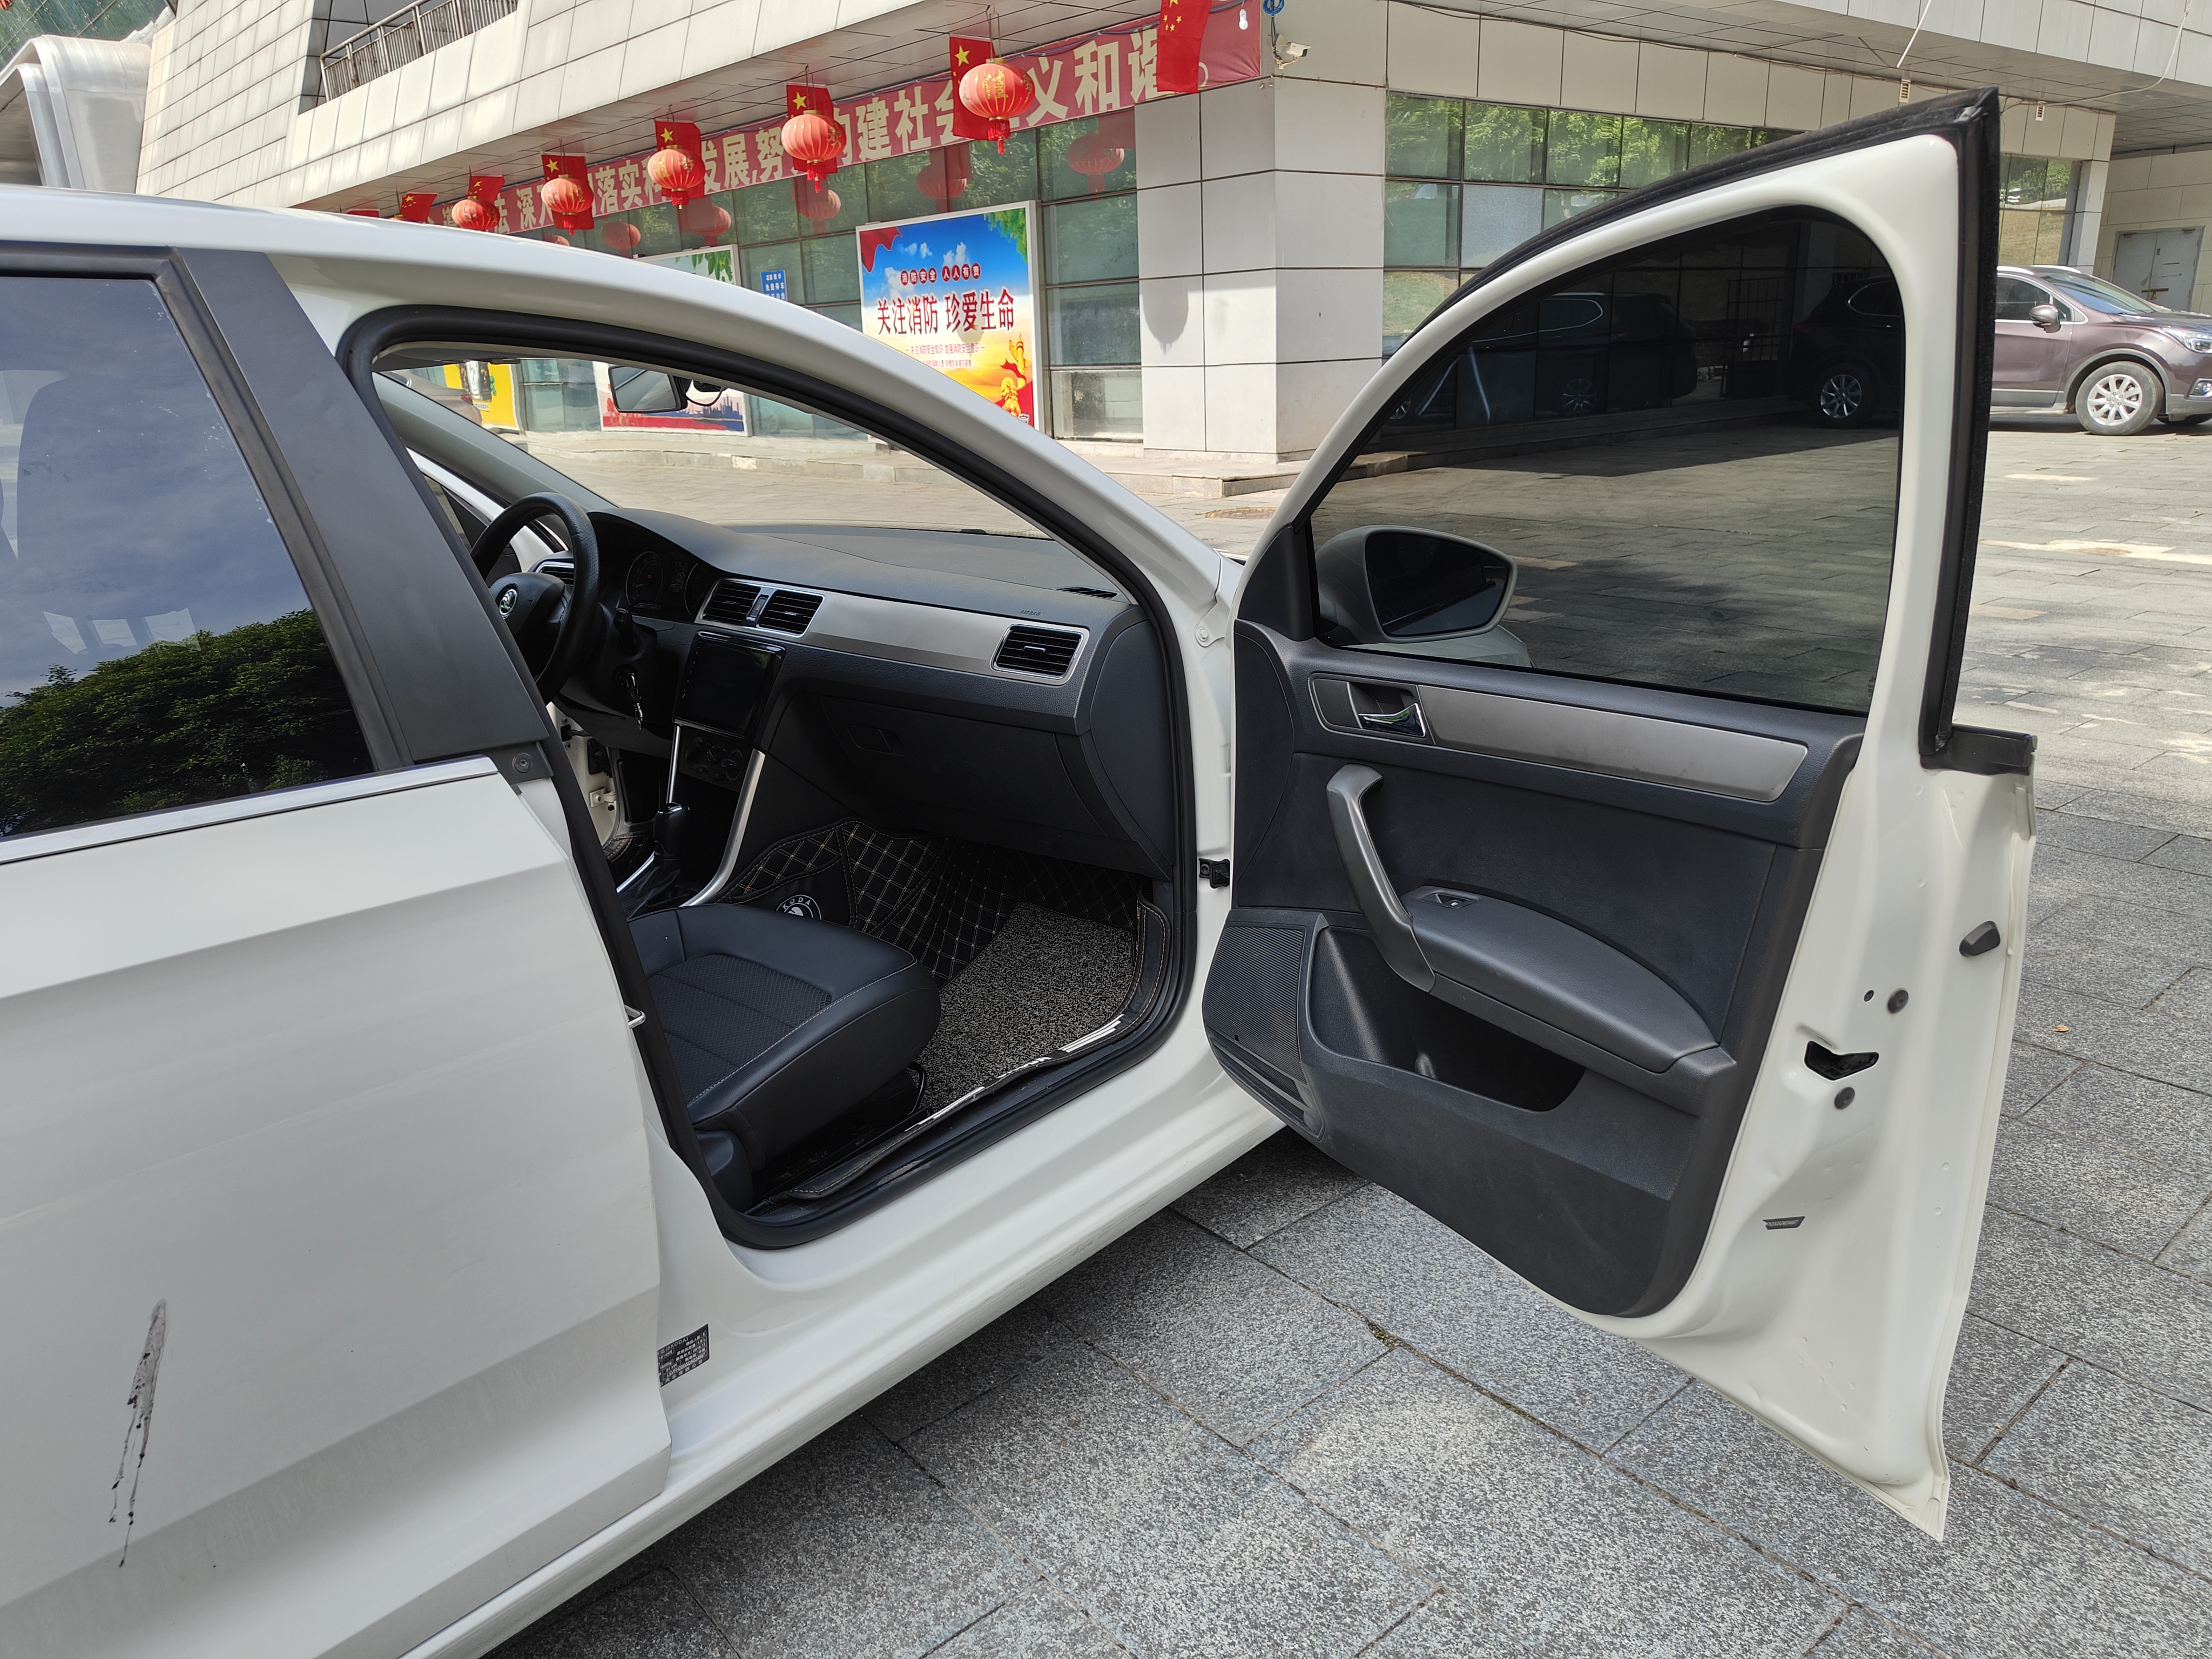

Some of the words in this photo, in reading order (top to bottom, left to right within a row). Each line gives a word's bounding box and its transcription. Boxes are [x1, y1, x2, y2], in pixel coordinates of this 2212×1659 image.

[901, 269, 936, 284] 消防安全
[942, 264, 980, 280] 人人有责
[877, 295, 938, 335] 关注消防
[945, 287, 1015, 333] 珍爱生命
[783, 897, 811, 910] KODA
